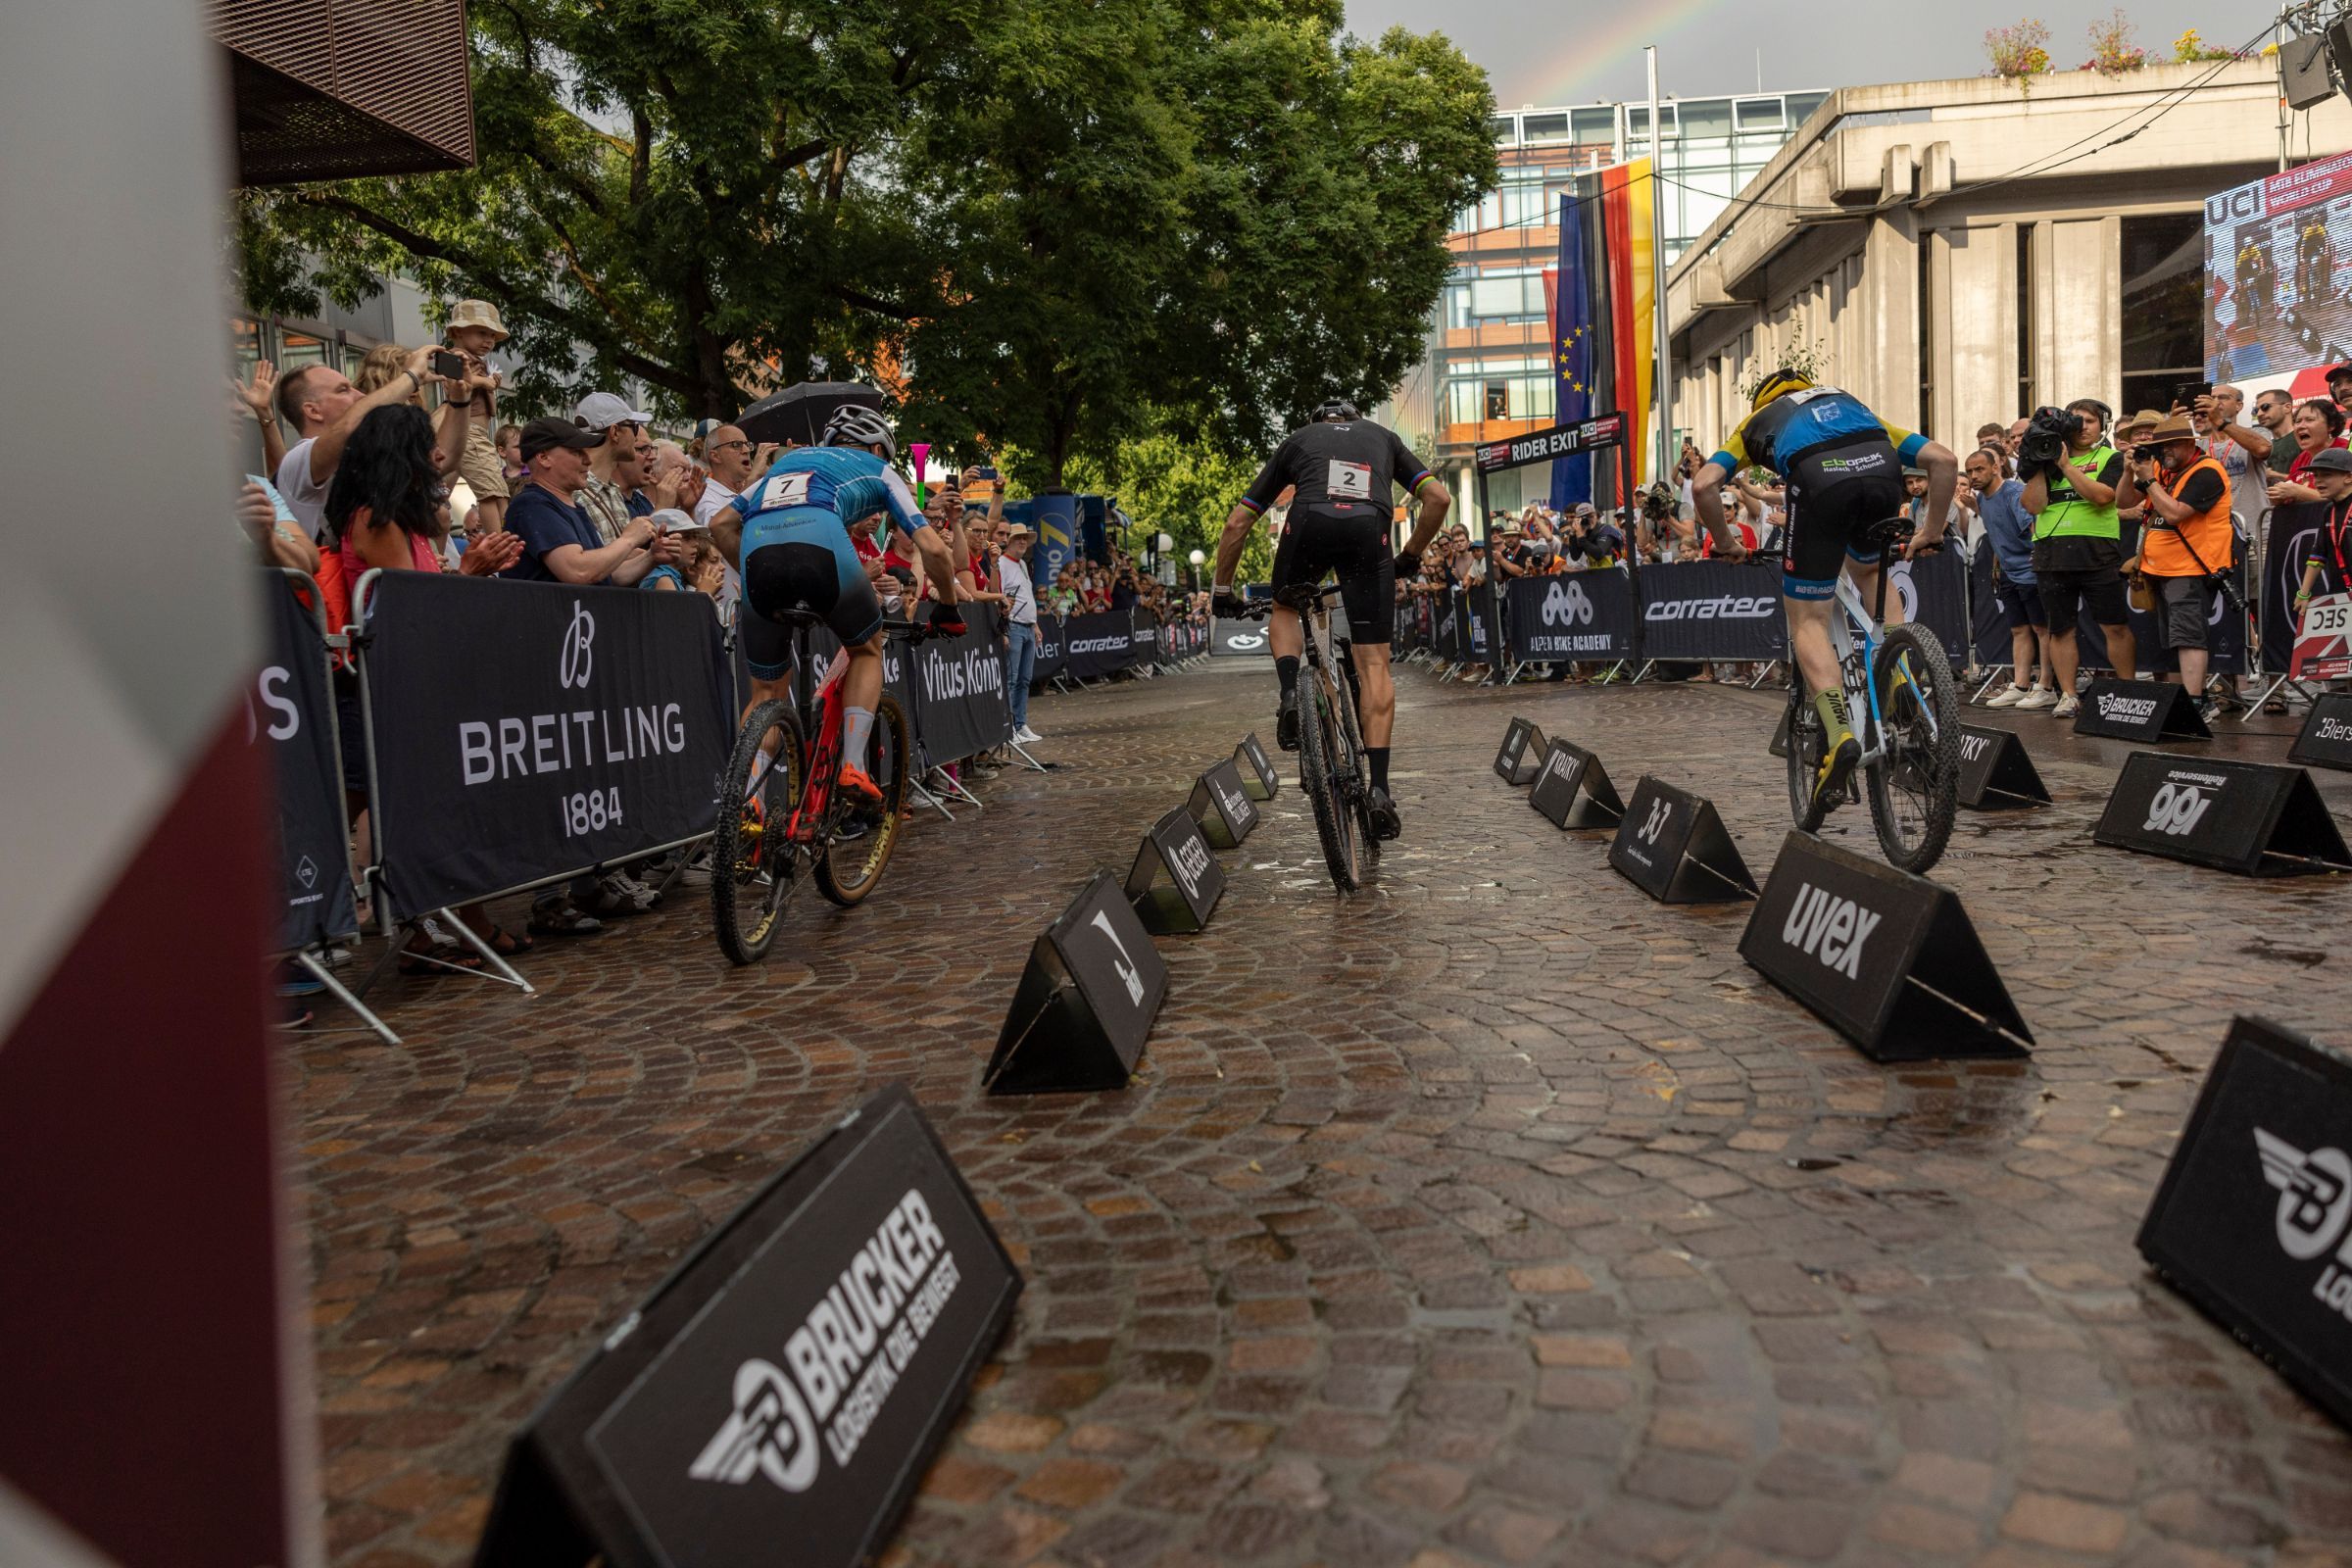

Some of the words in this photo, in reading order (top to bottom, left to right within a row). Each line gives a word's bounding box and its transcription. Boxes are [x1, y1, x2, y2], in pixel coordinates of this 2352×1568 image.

[2206, 185, 2260, 226] UCI
[2270, 187, 2310, 207] WORLD
[2311, 177, 2333, 194] CUP
[1583, 424, 1595, 434] UCI
[1512, 439, 1547, 462] RIDER
[1550, 429, 1579, 453] EXIT
[1343, 471, 1356, 487] 2
[1855, 459, 1886, 472] Schonach
[780, 479, 794, 494] 7
[1644, 594, 1777, 621] corratec
[1069, 634, 1130, 654] corratec
[1530, 636, 1553, 652] ALPEN
[1554, 635, 1572, 652] BIKE
[1573, 634, 1612, 651] ACADEMY
[923, 647, 964, 703] Vitus
[964, 644, 1004, 701] König
[1825, 692, 1849, 725] MAVIC
[2110, 697, 2157, 716] BRUCKER
[459, 703, 686, 786] BREITLING
[1552, 750, 1579, 782] KRATKY
[2168, 769, 2228, 786] Reifenservice
[562, 786, 623, 839] 1884
[1179, 835, 1210, 881] GEIGER
[1783, 882, 1882, 981] uvex
[783, 1188, 945, 1423] BRUCKER
[824, 1348, 900, 1467] LOGISTIK
[884, 1317, 919, 1373] DIE
[905, 1250, 961, 1341] BEWEGT
